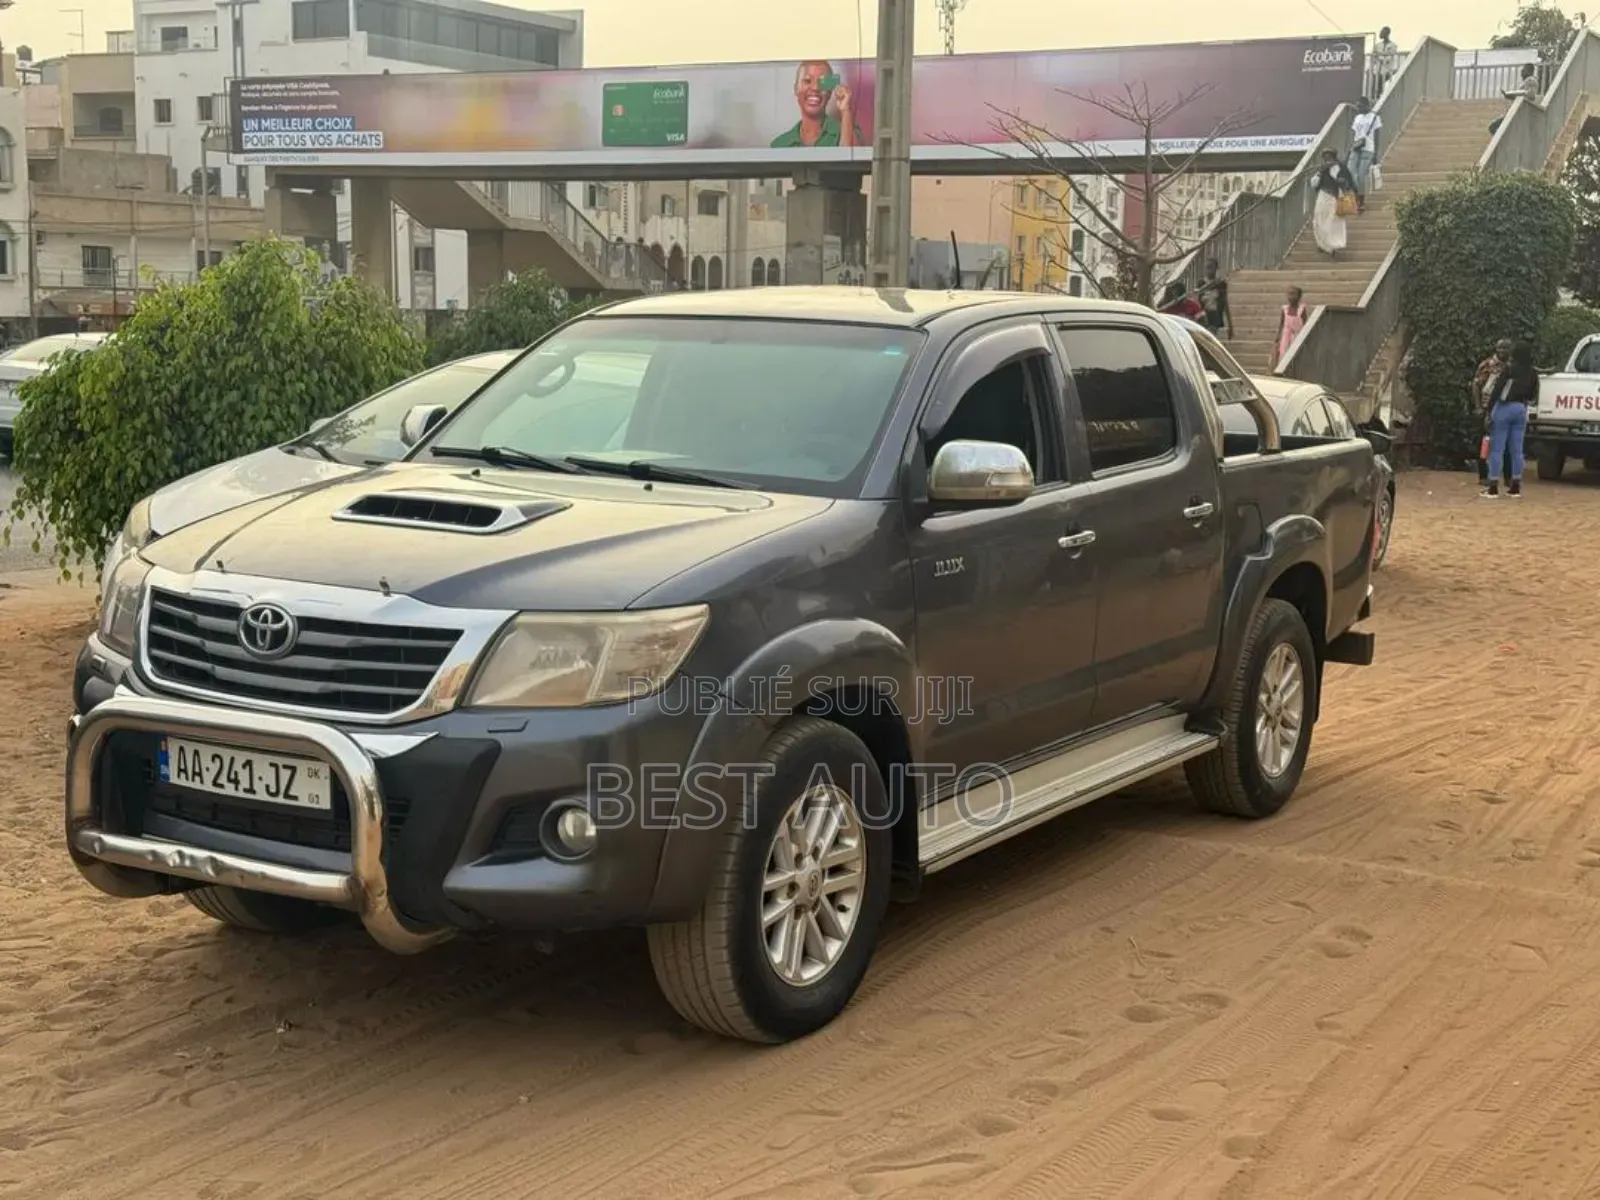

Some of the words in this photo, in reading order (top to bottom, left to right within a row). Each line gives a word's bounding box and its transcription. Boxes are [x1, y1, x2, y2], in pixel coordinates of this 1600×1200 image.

[1304, 45, 1354, 63] Ecobank
[243, 119, 259, 131] UN
[261, 118, 313, 131] MEILLEUR
[314, 117, 353, 130] CHOIX
[244, 134, 275, 147] POUR
[276, 134, 308, 147] TOUS
[308, 134, 333, 146] VOS
[335, 133, 382, 146] ACHATS
[666, 132, 685, 142] VISA
[1159, 141, 1197, 150] MEILLEUR
[1225, 139, 1248, 148] POUR
[1250, 139, 1266, 147] UNE
[1268, 138, 1305, 147] AFRIQUE
[307, 767, 321, 780] DK
